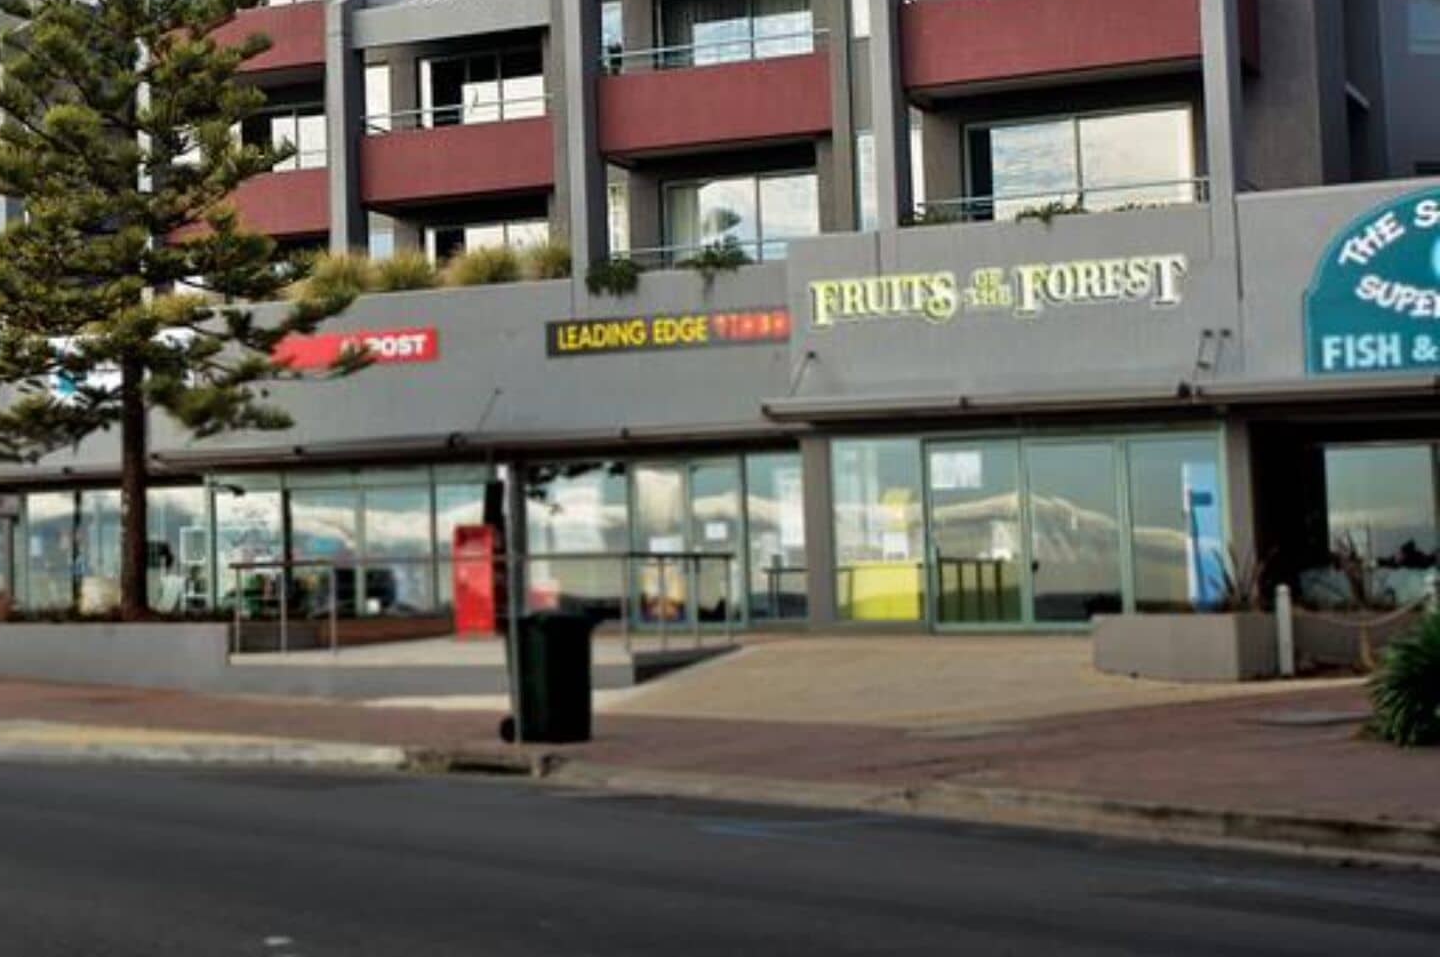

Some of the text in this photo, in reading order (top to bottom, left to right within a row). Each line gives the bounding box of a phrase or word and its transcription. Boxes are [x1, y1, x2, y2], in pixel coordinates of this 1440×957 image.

[1338, 211, 1406, 265] THE
[809, 270, 956, 327] FRUITS
[1013, 254, 1187, 318] FOREST
[557, 319, 647, 351] LEADING
[653, 315, 709, 344] EDGE
[1322, 332, 1439, 370] FISH &
